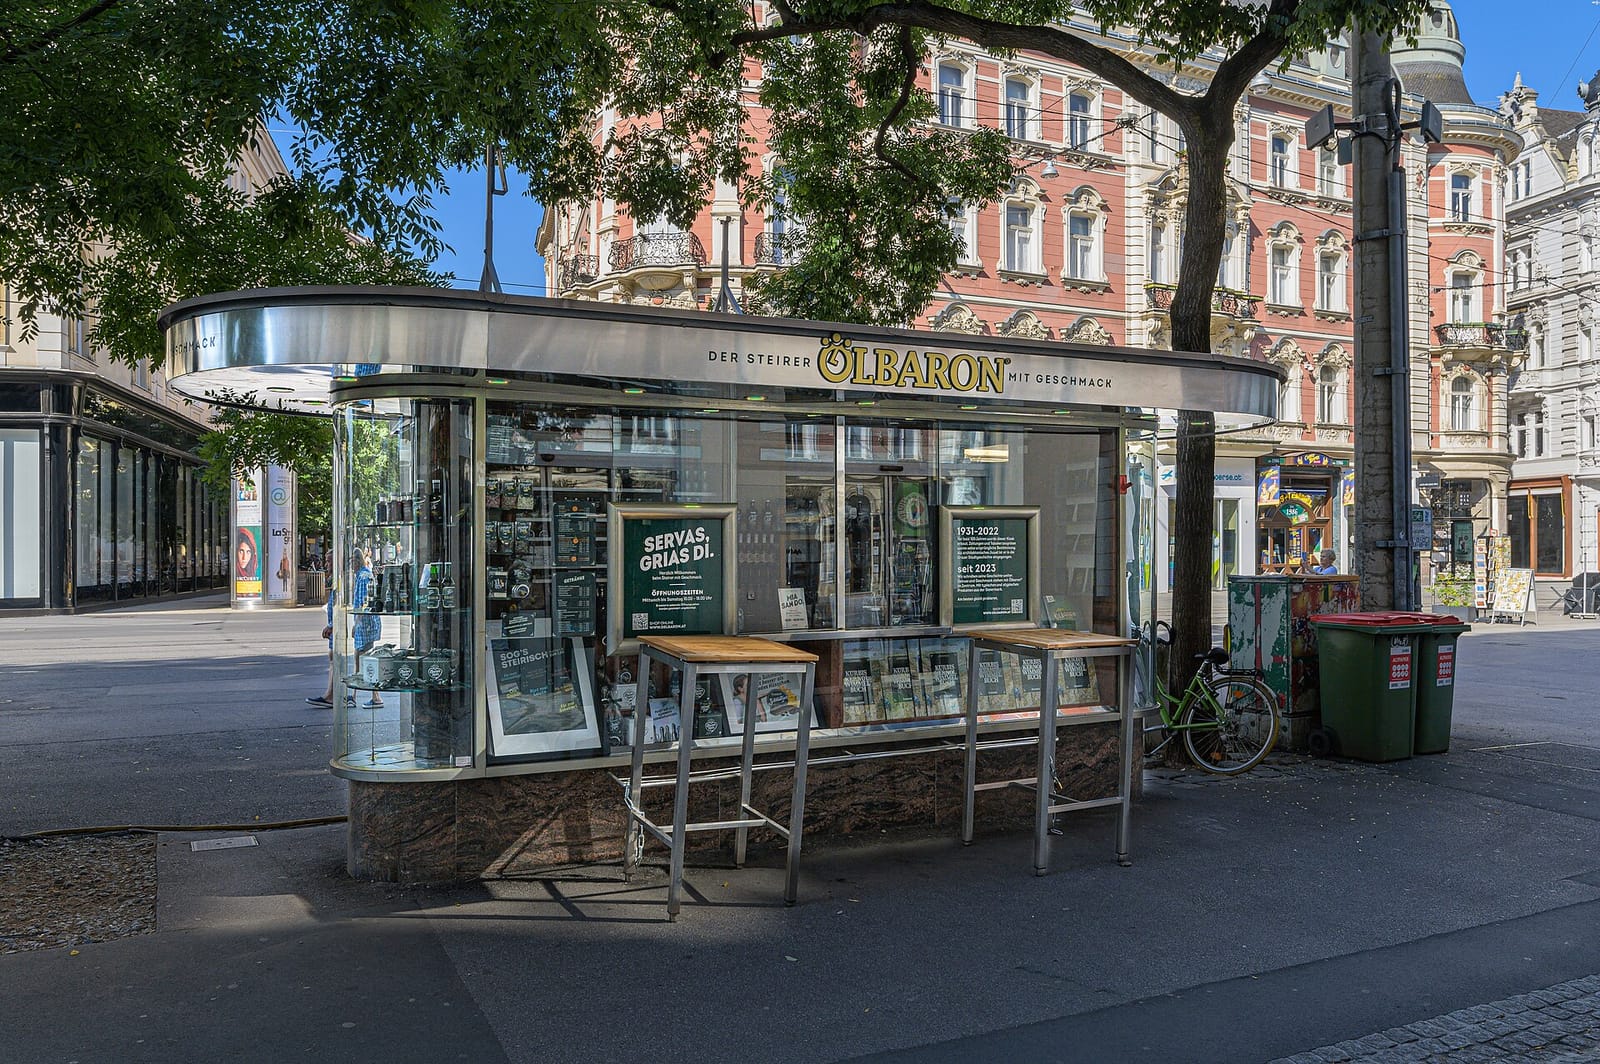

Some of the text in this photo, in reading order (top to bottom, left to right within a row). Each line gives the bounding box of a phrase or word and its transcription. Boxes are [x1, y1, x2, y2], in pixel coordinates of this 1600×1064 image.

[708, 350, 739, 364] DER
[747, 352, 812, 368] STEIRER
[1008, 372, 1031, 384] MIT
[1036, 374, 1112, 388] GESCHMACK
[957, 526, 999, 535] 1931-2022
[644, 526, 710, 553] SERVAS,
[640, 548, 690, 571] GRIAS
[957, 564, 996, 573] seit 2023
[500, 648, 529, 661] SOG'S
[501, 652, 549, 668] STEIRISCH
